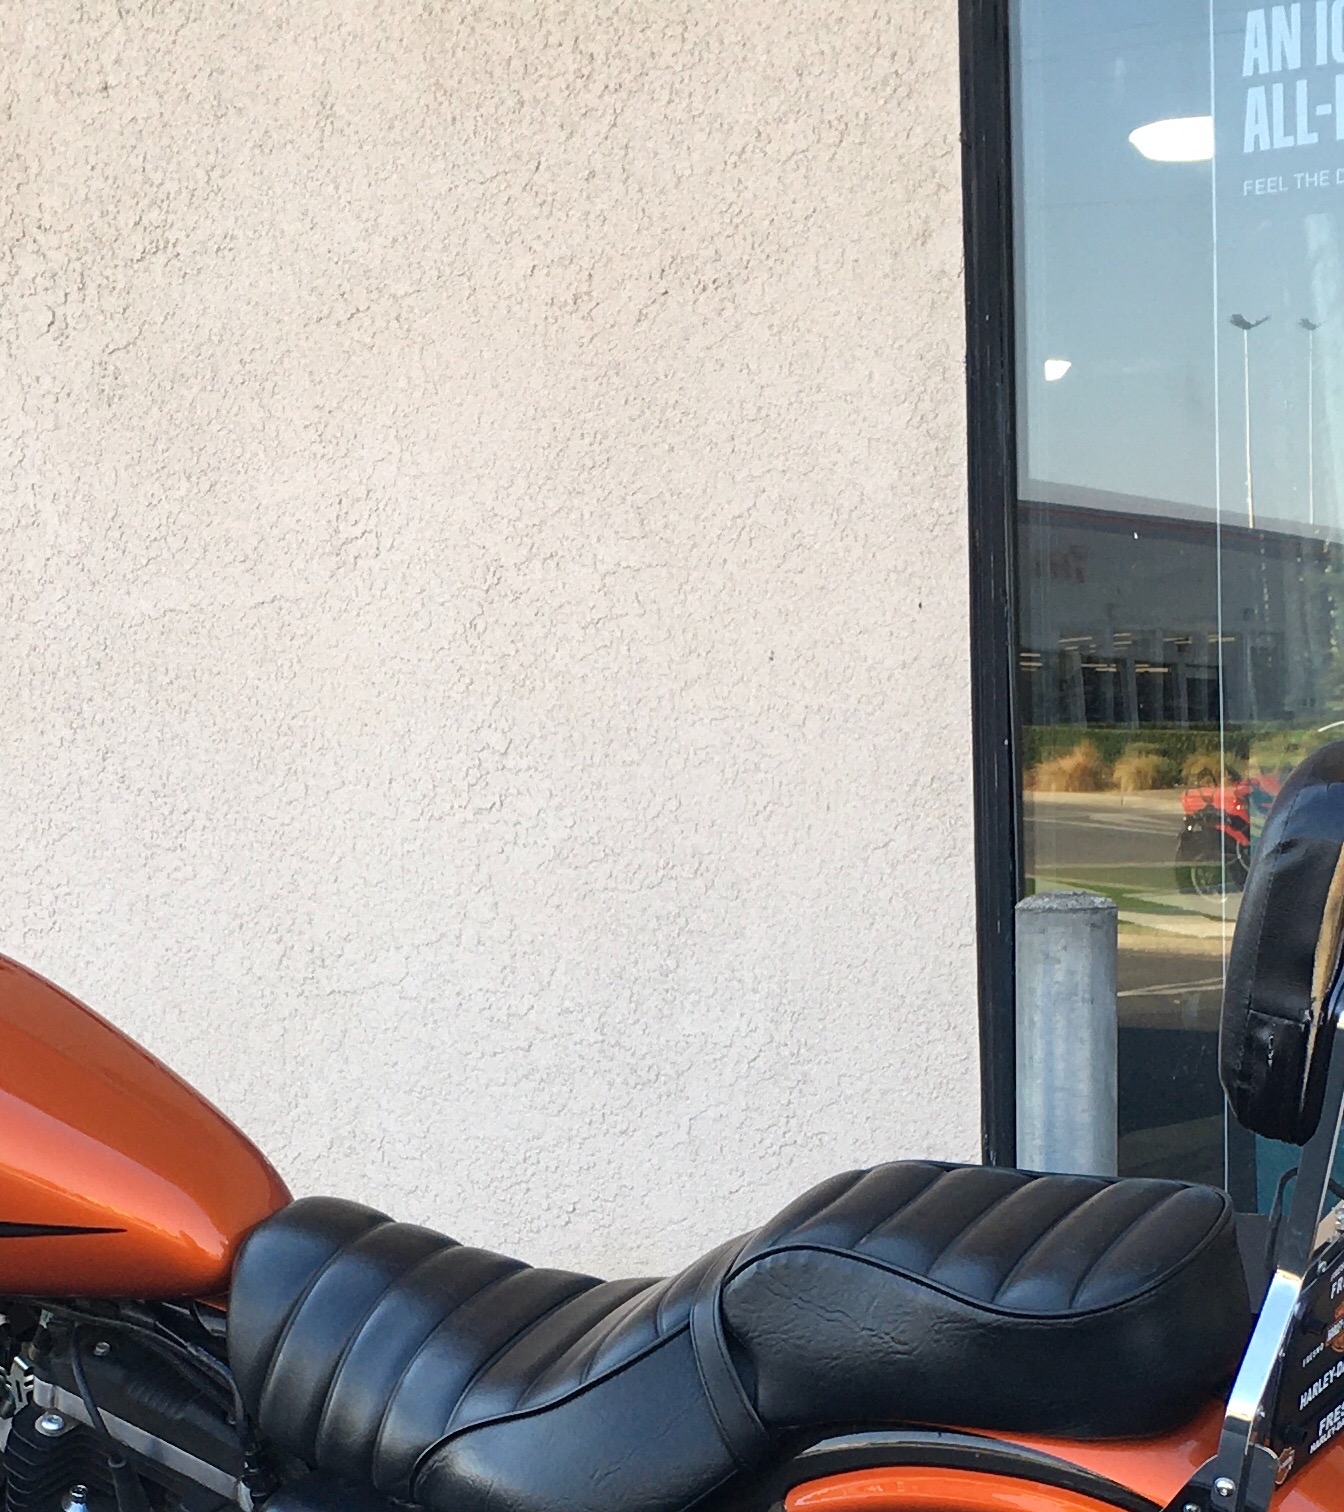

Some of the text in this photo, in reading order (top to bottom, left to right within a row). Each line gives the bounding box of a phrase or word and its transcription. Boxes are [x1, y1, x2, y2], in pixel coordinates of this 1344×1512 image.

[1242, 3, 1301, 77] AN
[1243, 175, 1289, 196] FEEL
[1294, 169, 1330, 189] THE
